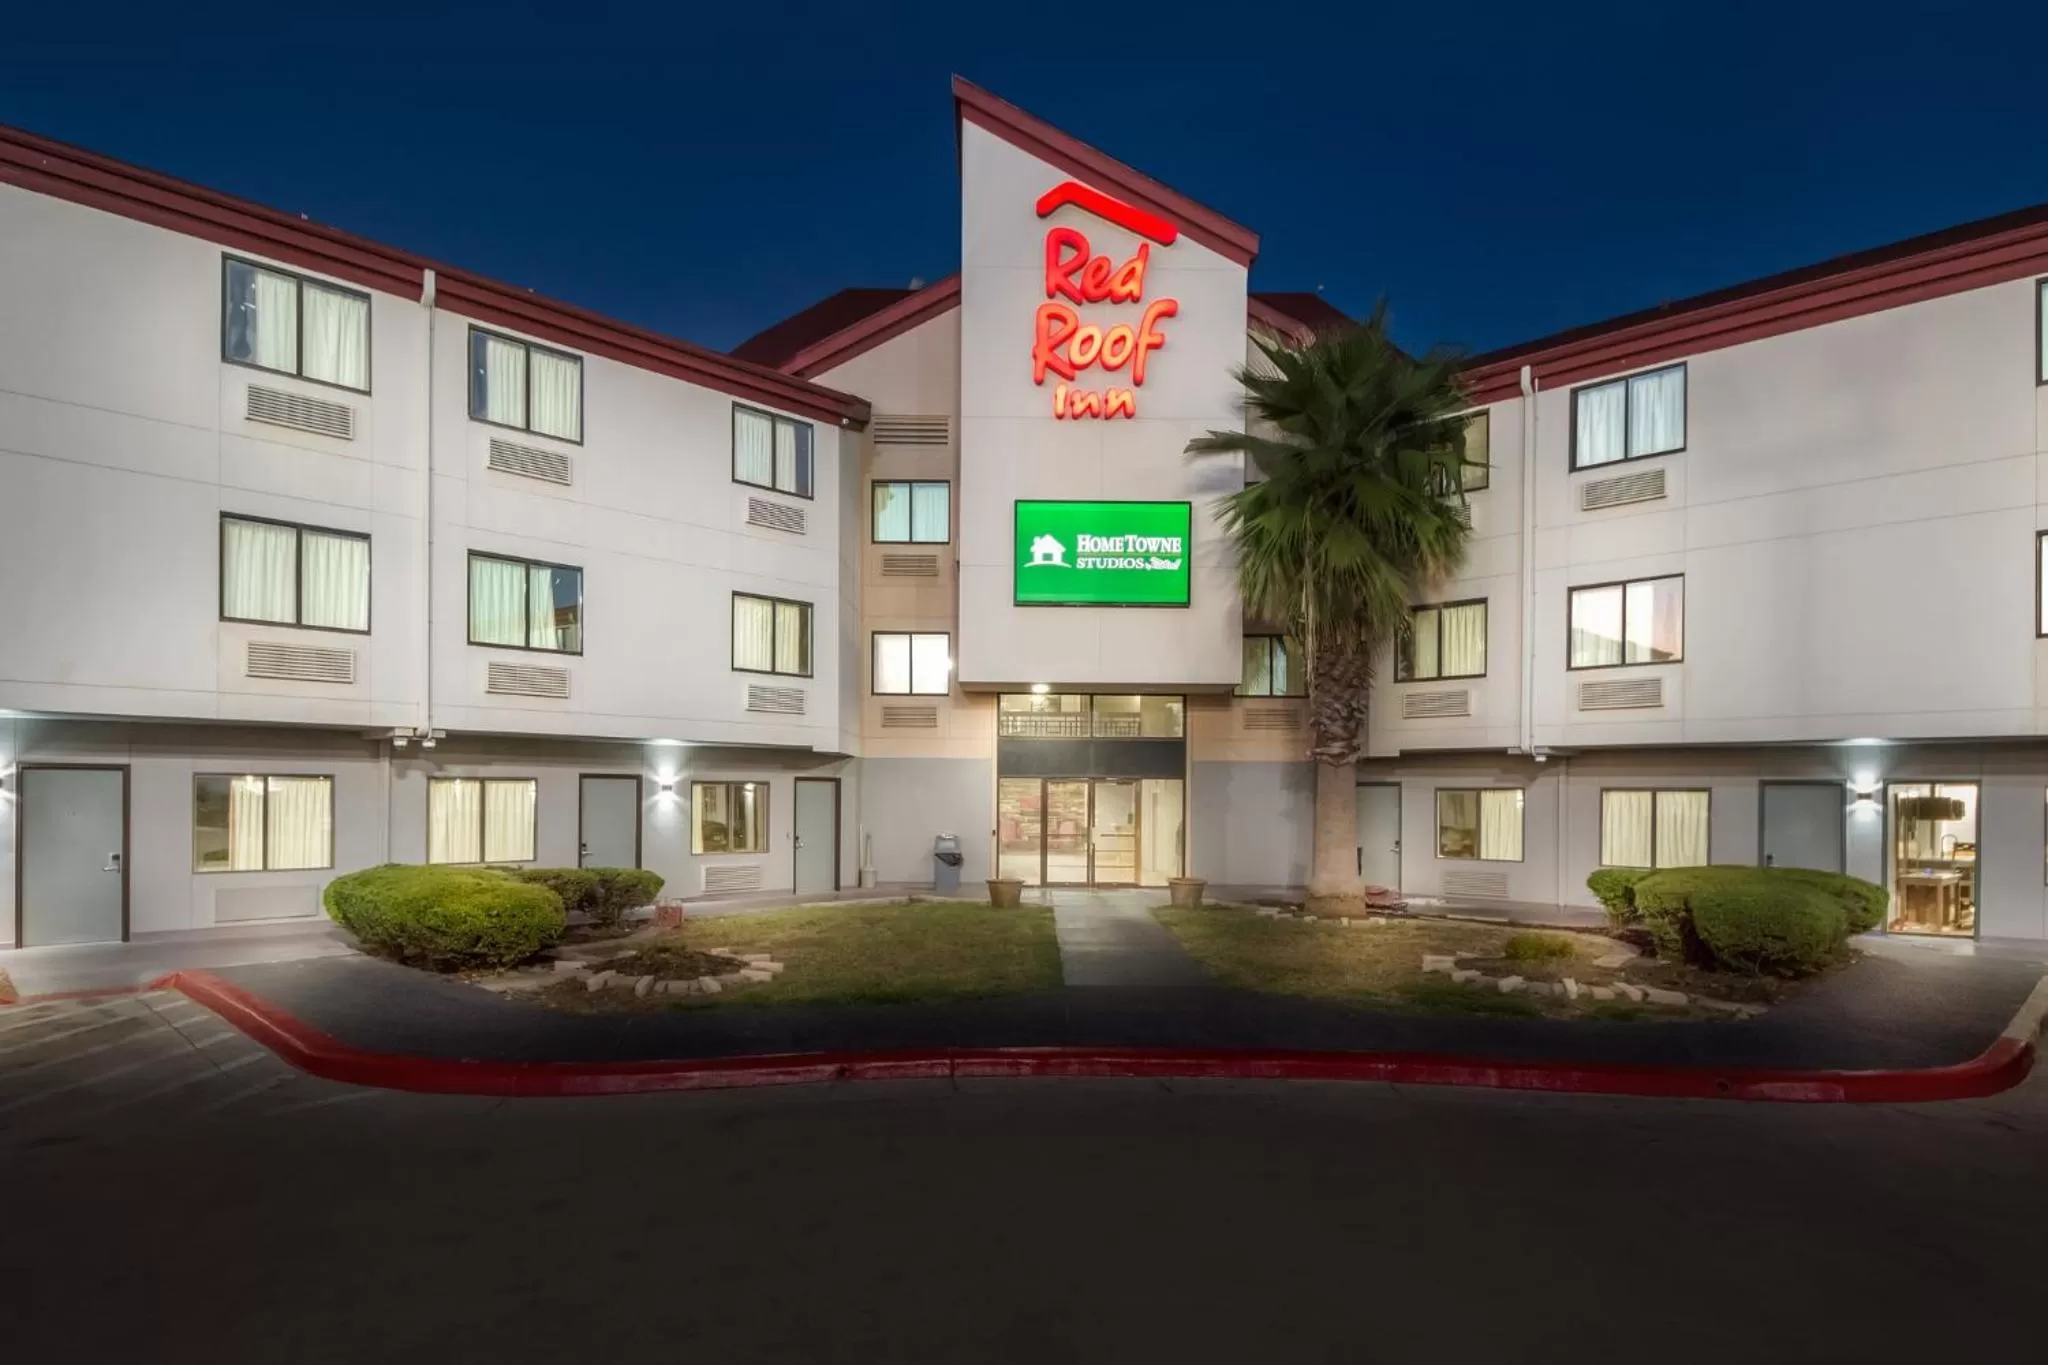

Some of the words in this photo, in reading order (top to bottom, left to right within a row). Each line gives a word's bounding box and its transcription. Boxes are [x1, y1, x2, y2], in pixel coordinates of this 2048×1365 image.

[1046, 227, 1150, 305] Red
[1033, 299, 1178, 386] Roof
[1055, 384, 1136, 420] Inn
[1076, 557, 1144, 569] STUDIOS
